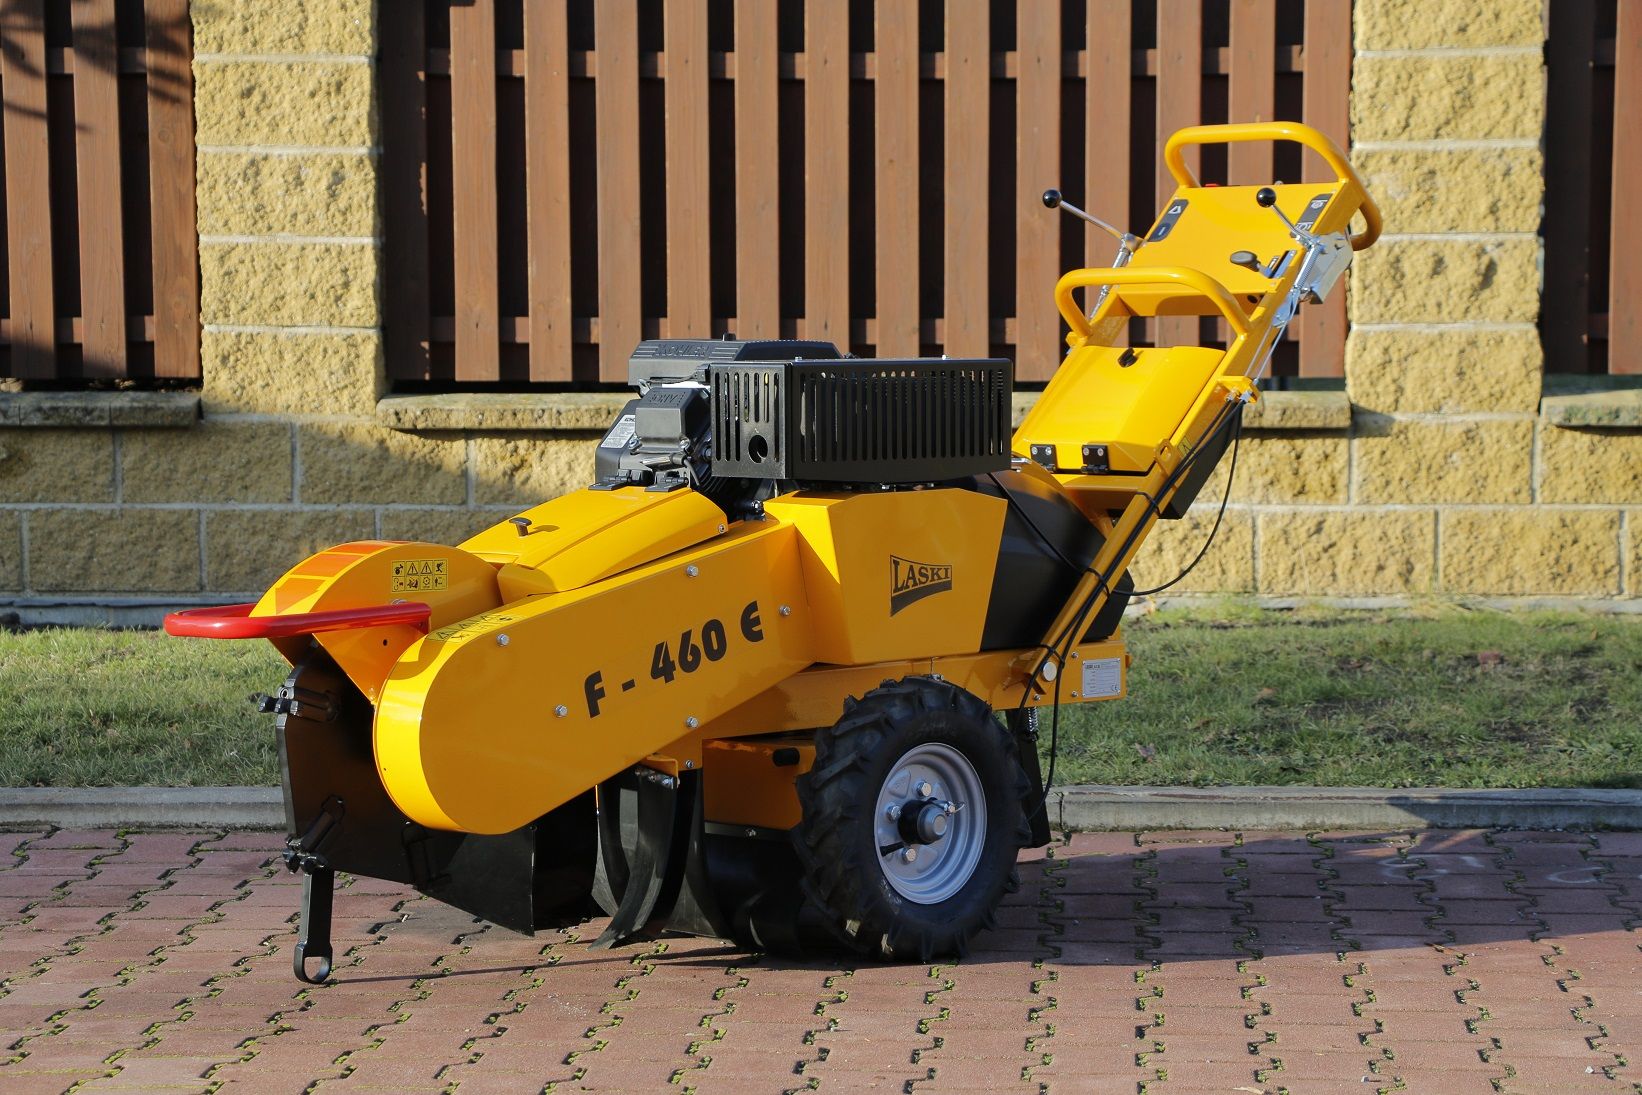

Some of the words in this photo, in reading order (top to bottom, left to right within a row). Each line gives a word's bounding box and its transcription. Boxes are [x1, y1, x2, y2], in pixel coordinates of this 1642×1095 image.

[892, 560, 950, 593] LASKI
[584, 670, 606, 718] F
[650, 618, 727, 684] 460
[741, 600, 764, 643] E
